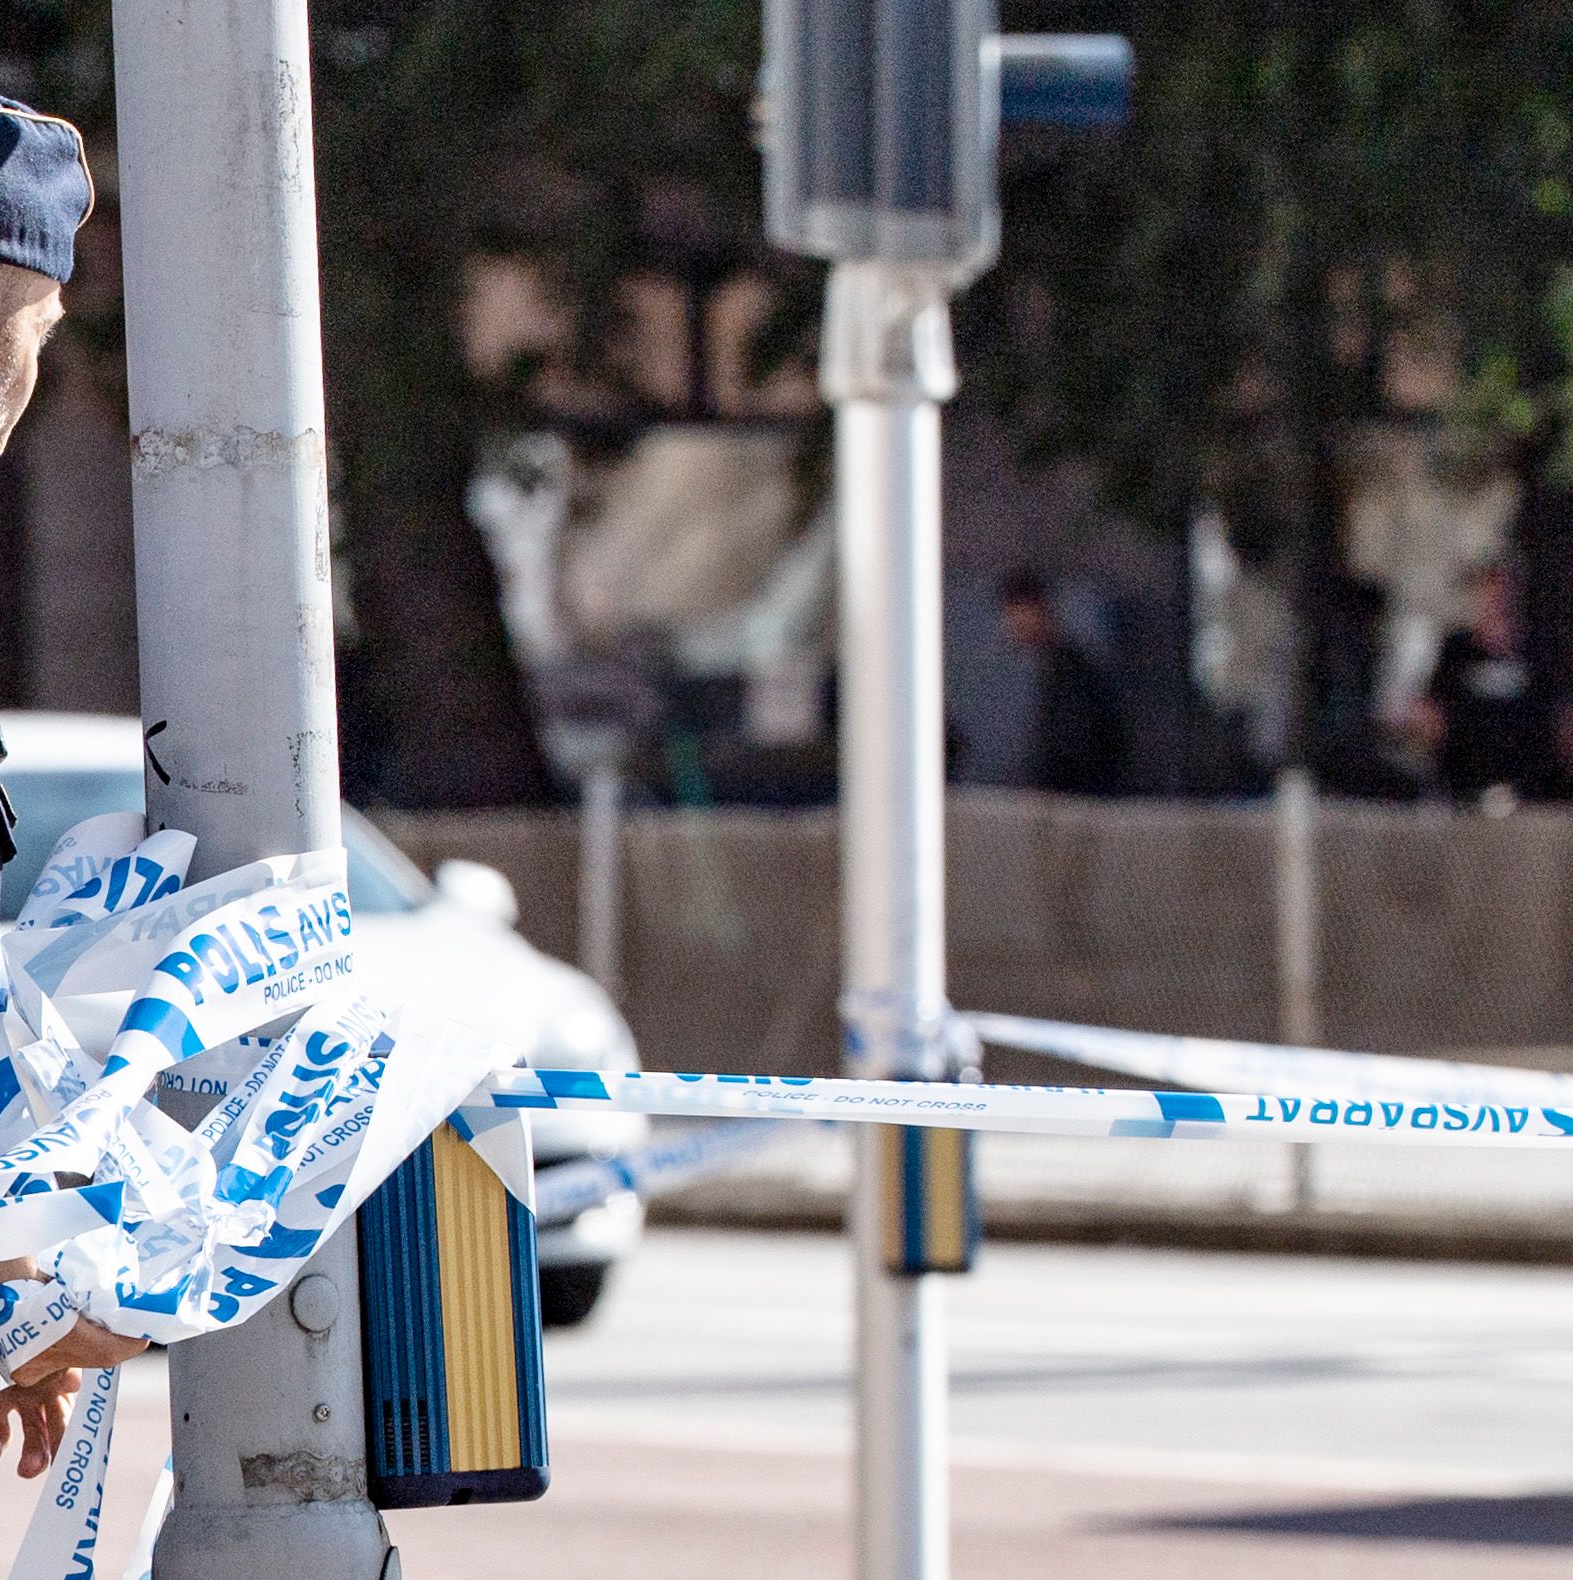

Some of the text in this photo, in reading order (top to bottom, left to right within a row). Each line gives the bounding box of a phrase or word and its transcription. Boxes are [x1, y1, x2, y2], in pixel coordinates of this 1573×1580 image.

[153, 904, 300, 1006] POLIS
[263, 975, 307, 1004] POLICE
[315, 964, 333, 985] DO
[337, 951, 354, 974] NO
[201, 1096, 248, 1144] POLICE
[245, 1069, 269, 1096] DO
[261, 1045, 286, 1078] NOT
[832, 1094, 864, 1105] DO
[868, 1096, 914, 1109] NOT
[916, 1100, 988, 1113] CROSS
[322, 1105, 375, 1147] CROSS
[82, 1392, 108, 1438] NOT
[55, 1438, 94, 1511] CROSS
